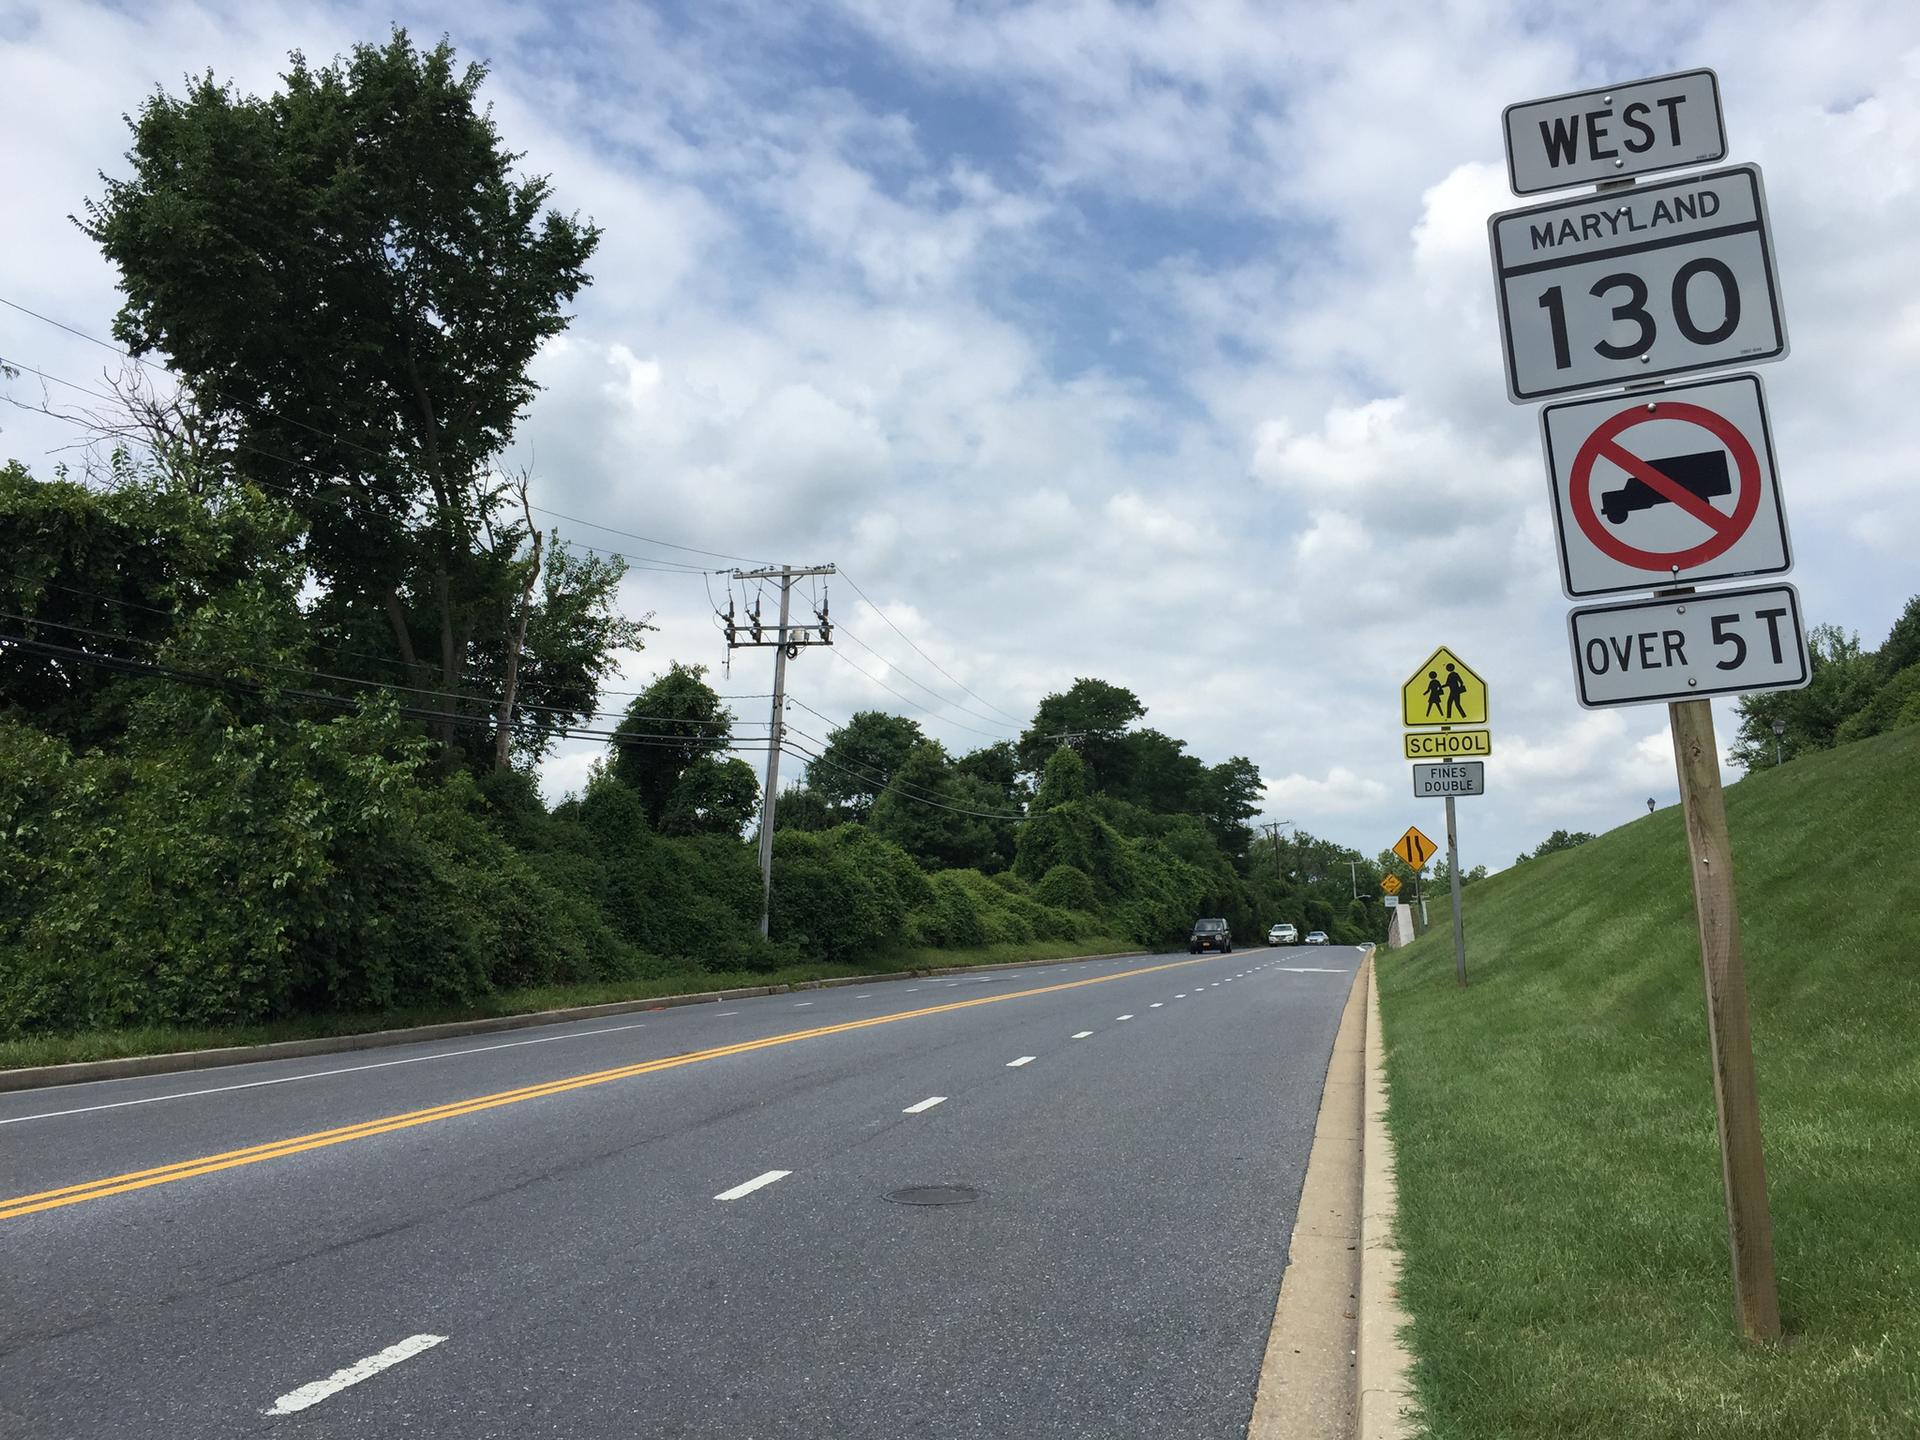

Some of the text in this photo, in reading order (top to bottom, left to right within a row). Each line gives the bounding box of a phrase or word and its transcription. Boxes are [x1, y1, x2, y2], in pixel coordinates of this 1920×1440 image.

[1538, 95, 1686, 169] WEST
[1530, 190, 1720, 250] MARYLAND
[1538, 257, 1741, 370] 130
[1586, 607, 1787, 675] OVER 5T
[1410, 736, 1485, 753] SCHOOL
[1431, 767, 1467, 779] FINES
[1425, 780, 1474, 792] DOUBLE
